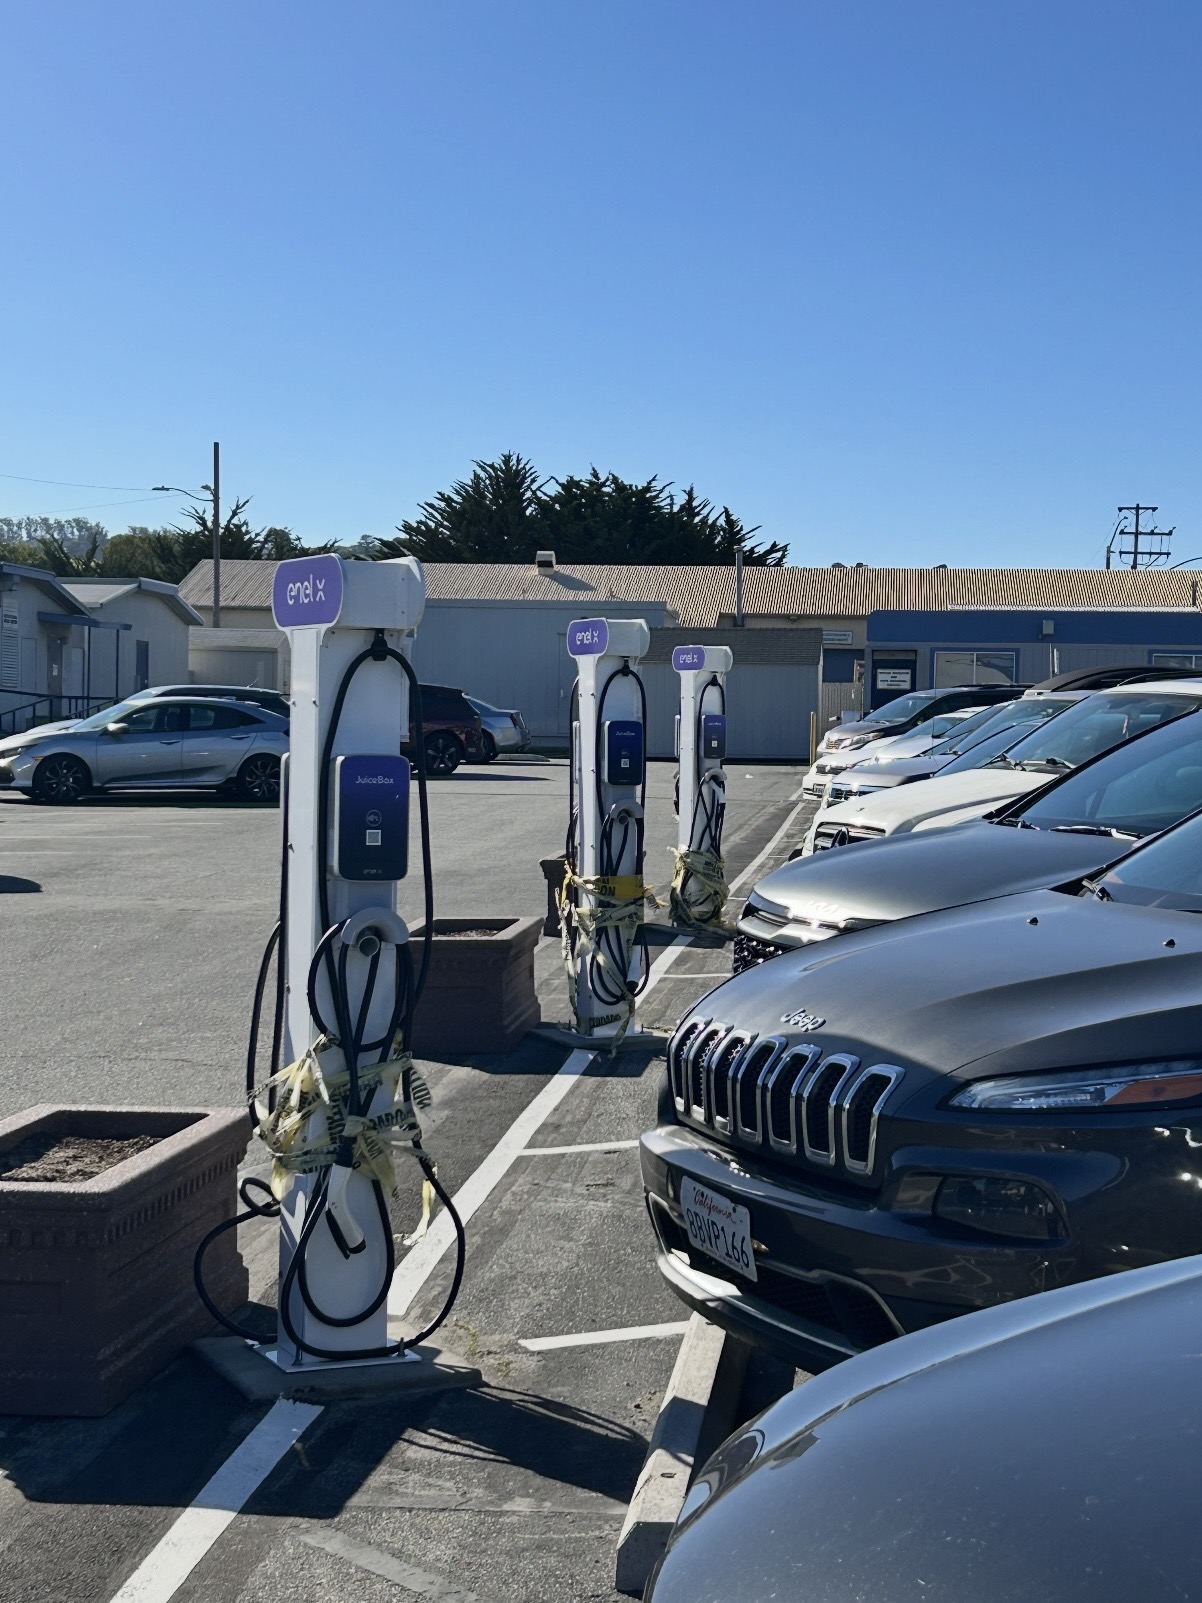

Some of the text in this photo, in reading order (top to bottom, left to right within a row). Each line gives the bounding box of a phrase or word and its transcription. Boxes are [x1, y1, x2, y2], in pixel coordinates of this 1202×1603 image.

[287, 574, 313, 605] enel
[576, 628, 592, 645] enel
[355, 775, 394, 784] JuiceBox
[780, 1008, 825, 1032] Jeep
[693, 1188, 736, 1225] California
[686, 1207, 750, 1268] 8BVP166
